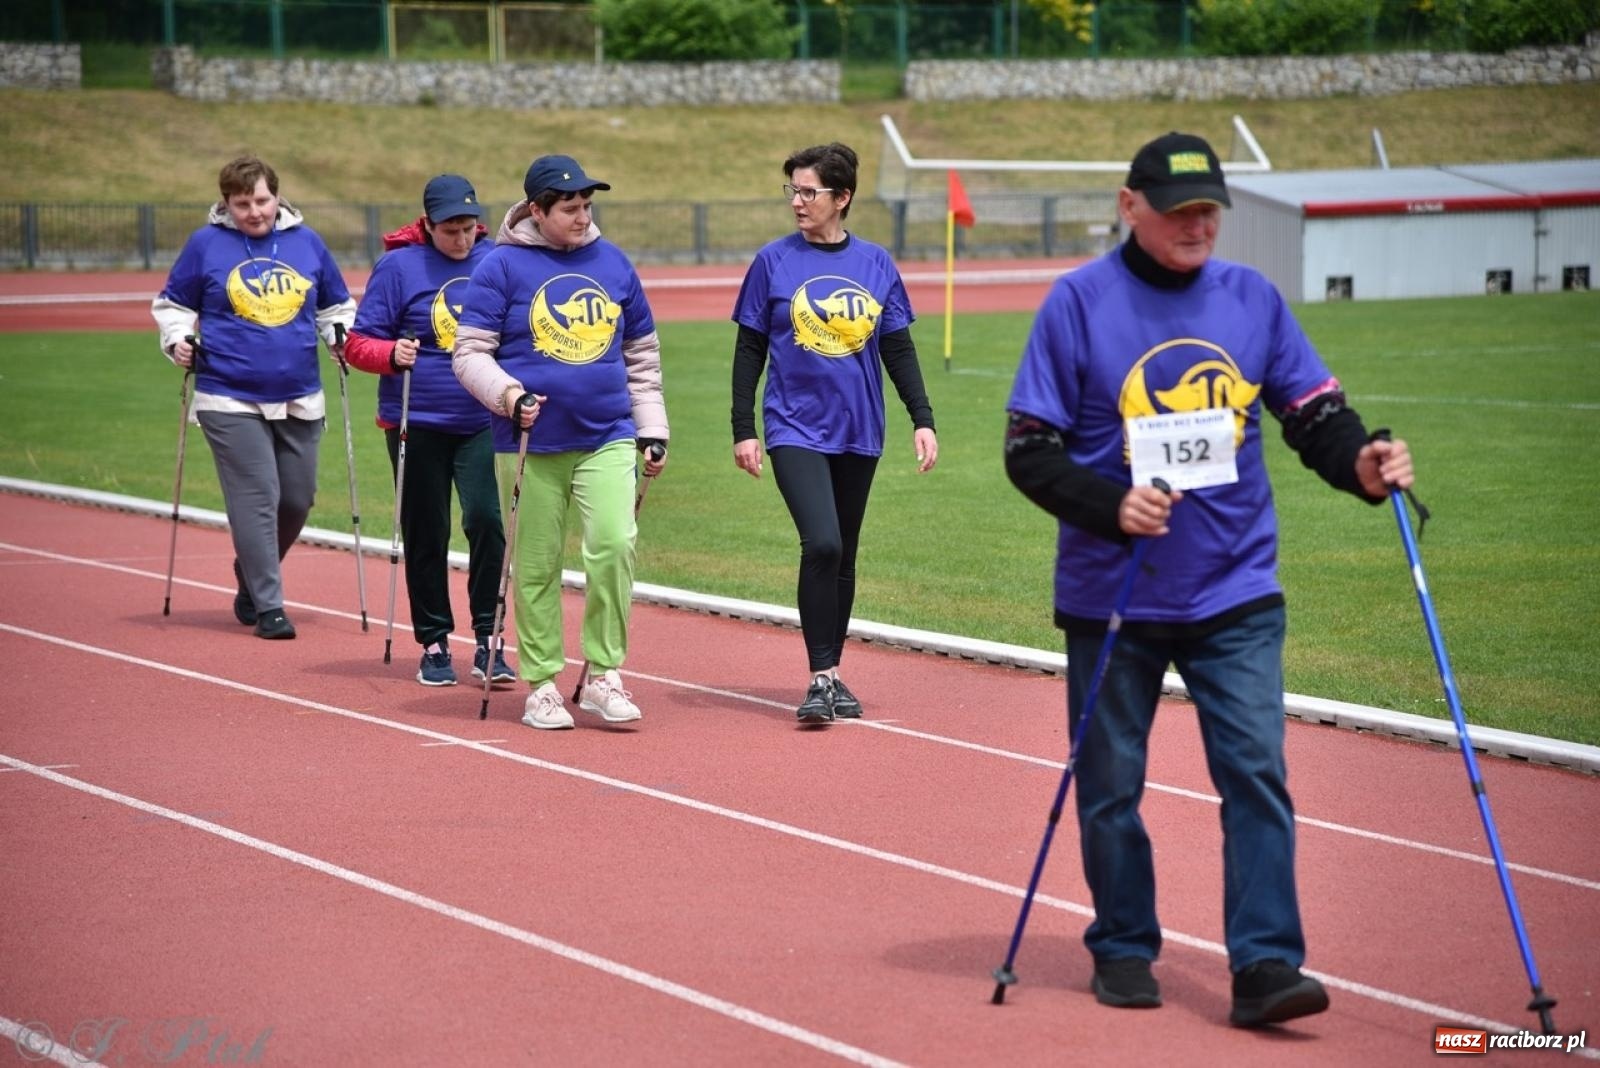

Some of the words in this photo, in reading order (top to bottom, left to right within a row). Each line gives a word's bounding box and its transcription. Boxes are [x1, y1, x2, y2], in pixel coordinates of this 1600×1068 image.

[537, 315, 583, 351] RACIBORSKI
[799, 310, 841, 344] RACIBORSKI
[1161, 437, 1211, 465] 152
